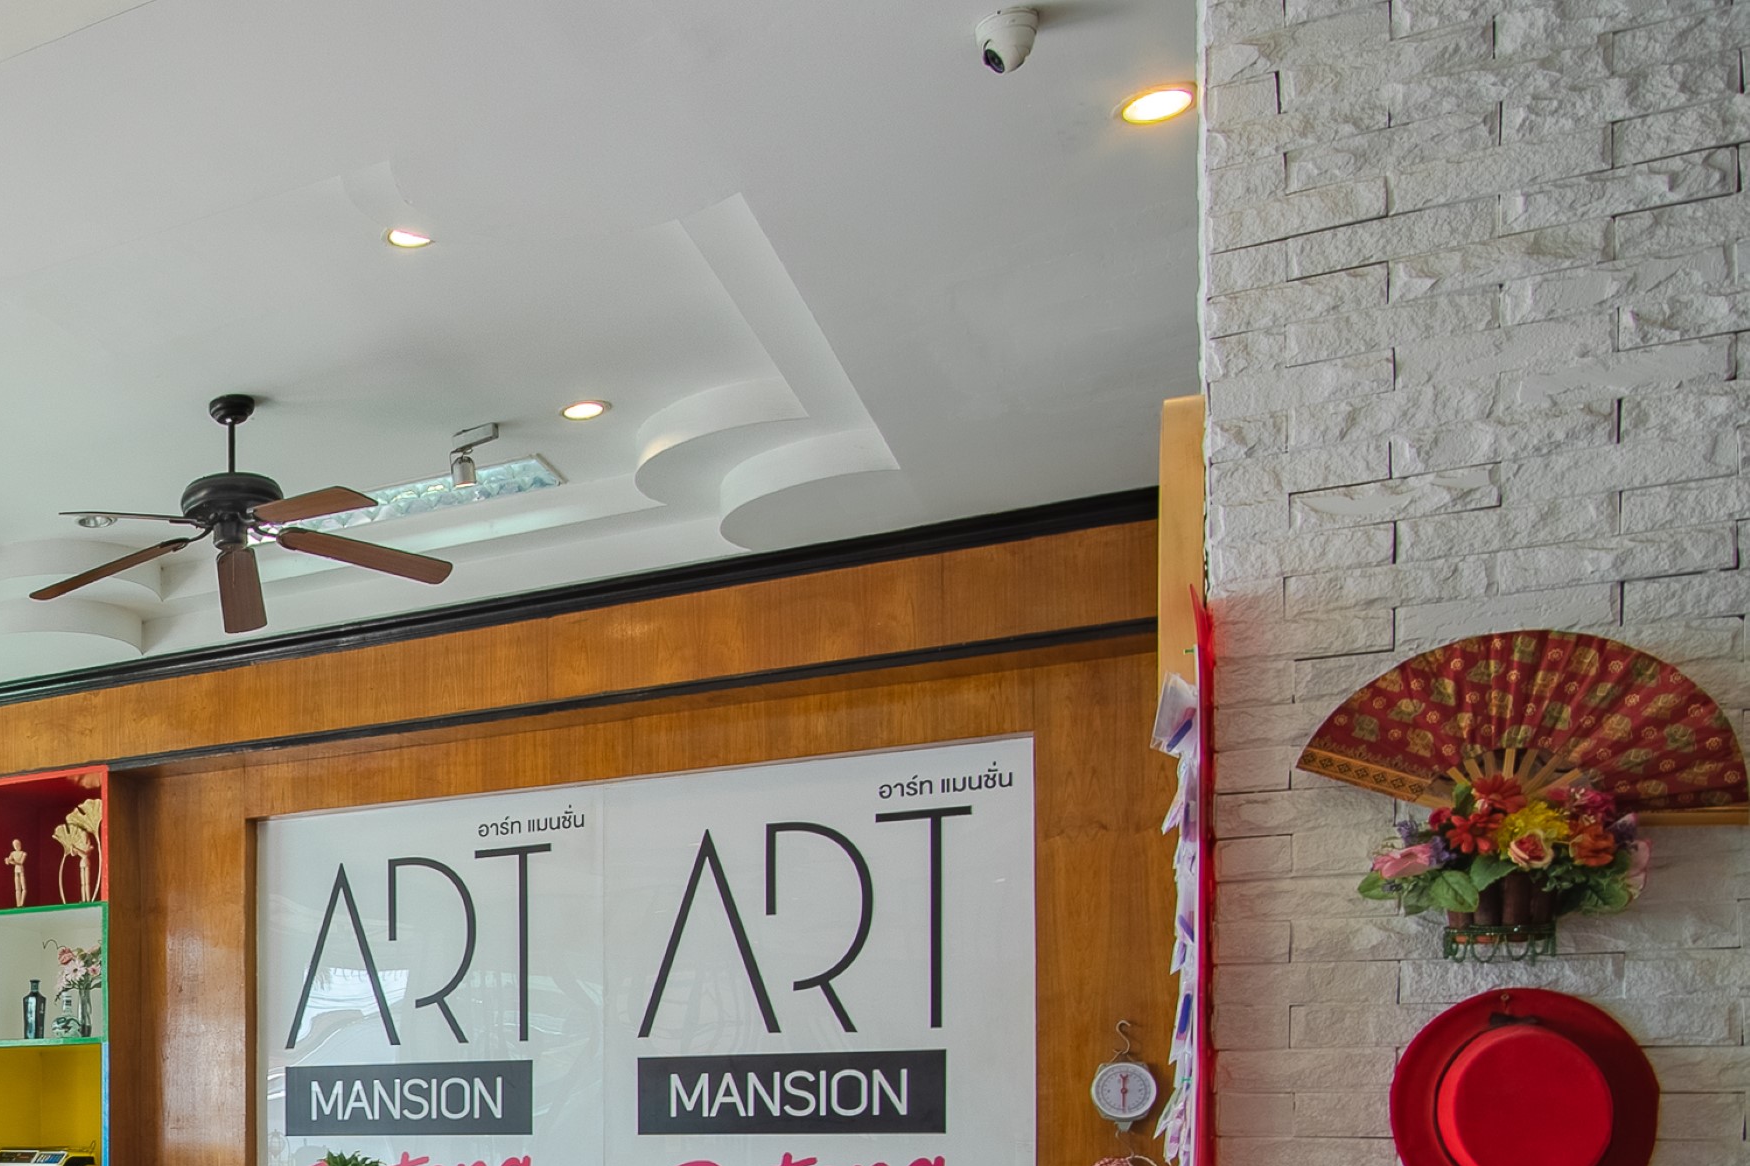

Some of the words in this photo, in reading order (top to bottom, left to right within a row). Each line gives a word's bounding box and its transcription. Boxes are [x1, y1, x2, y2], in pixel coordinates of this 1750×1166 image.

[878, 772, 933, 799] อาร์ท
[941, 764, 1014, 795] แมนชั่น
[478, 816, 522, 837] อาร์ท
[528, 804, 585, 833] แมนชั่น
[637, 805, 972, 1038] ART
[285, 843, 552, 1050] ART
[311, 1076, 502, 1121] MANSION
[670, 1067, 908, 1118] MANSION
